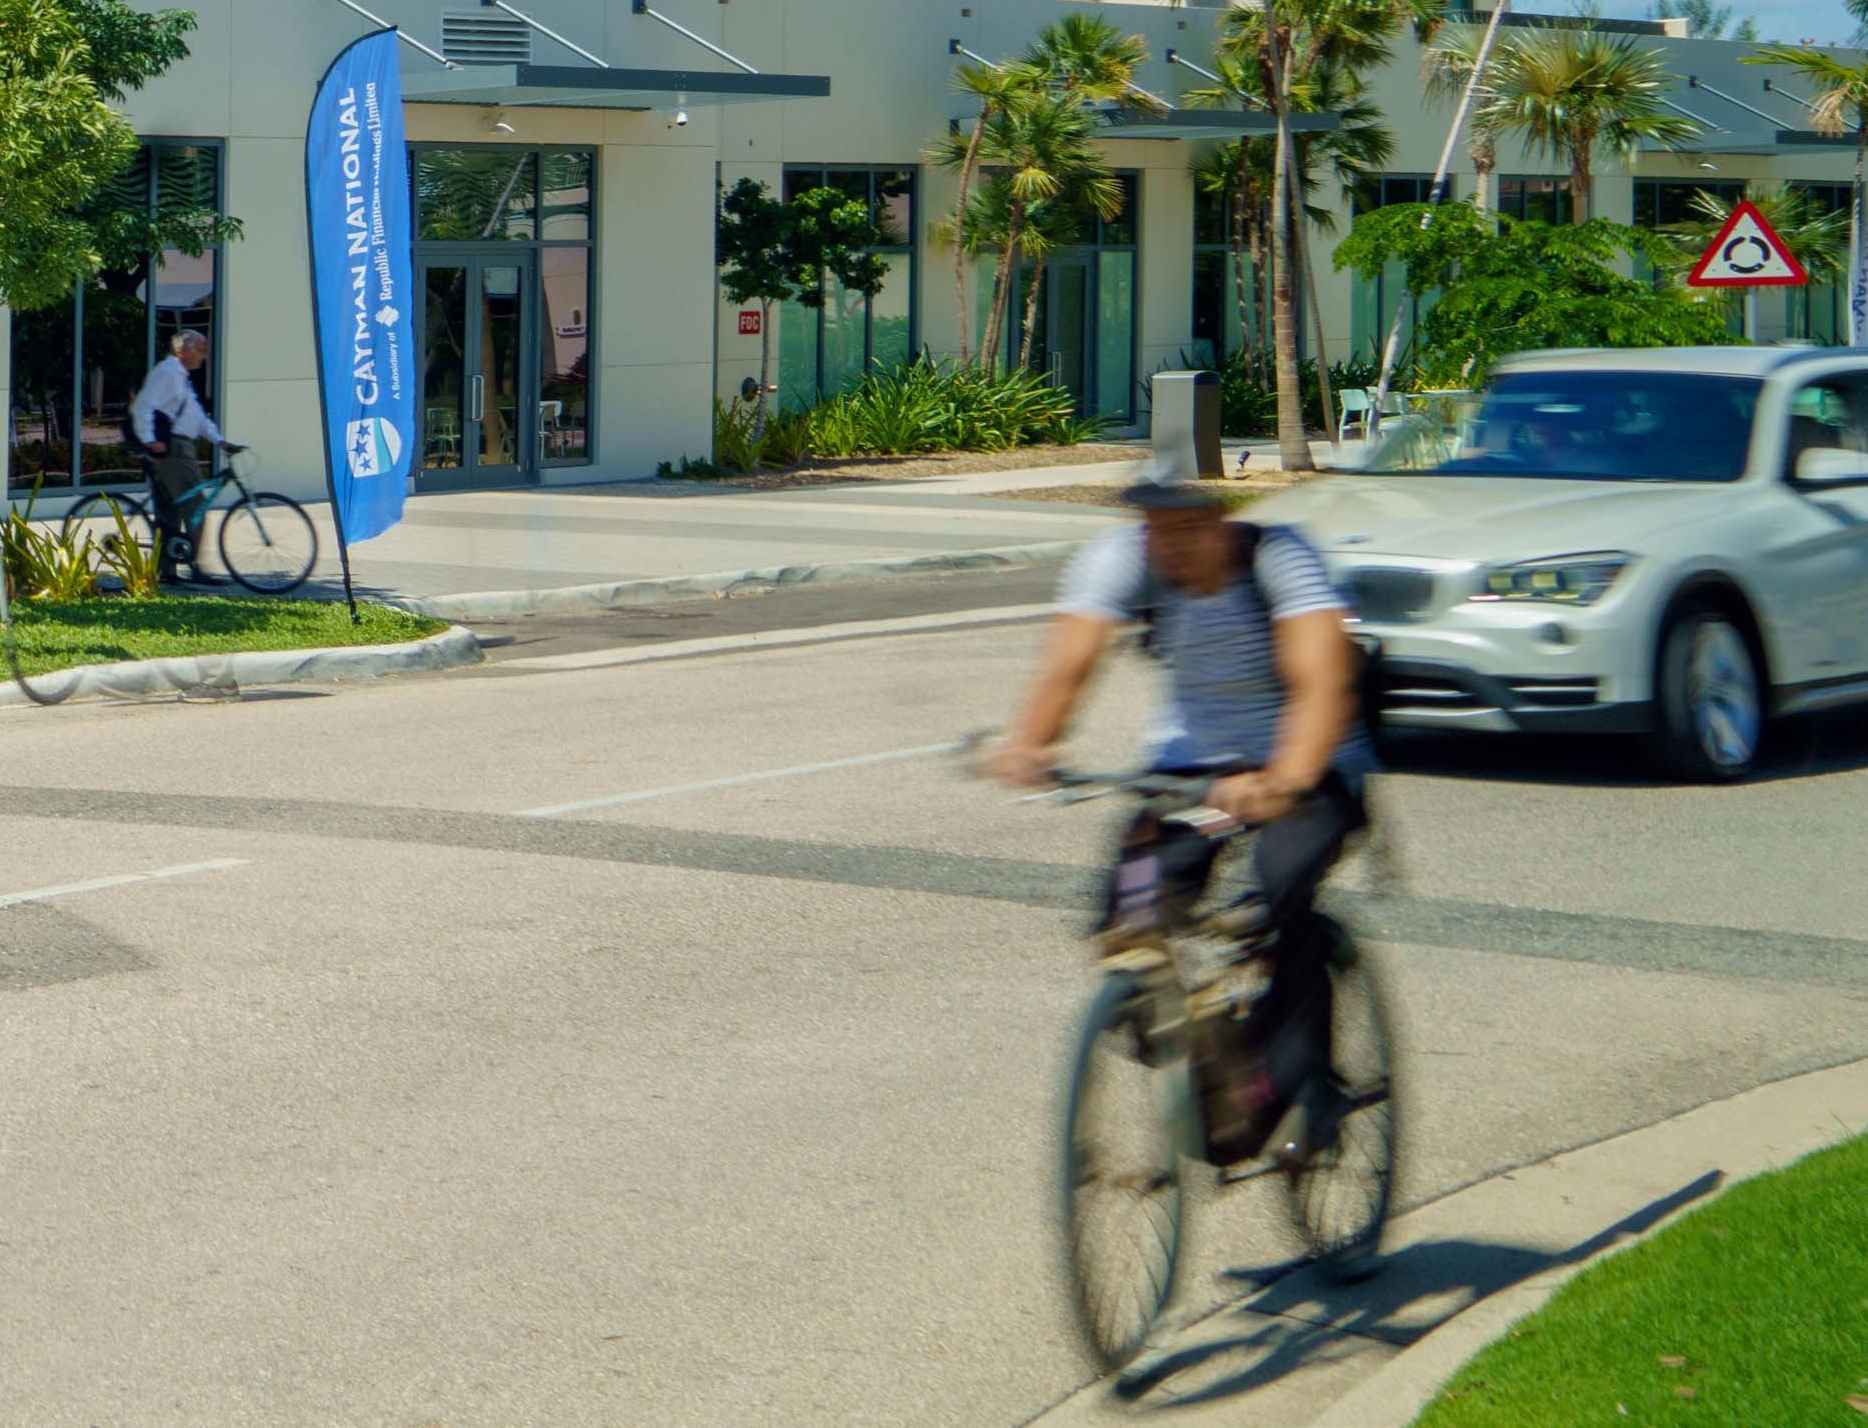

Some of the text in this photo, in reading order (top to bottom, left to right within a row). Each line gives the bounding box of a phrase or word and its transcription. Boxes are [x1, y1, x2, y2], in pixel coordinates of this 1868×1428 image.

[338, 87, 379, 406] CAYMAN NATIONAL
[373, 248, 394, 301] Republic
[386, 332, 396, 342] of
[740, 315, 759, 330] FDC
[389, 343, 401, 392] Subsidiary
